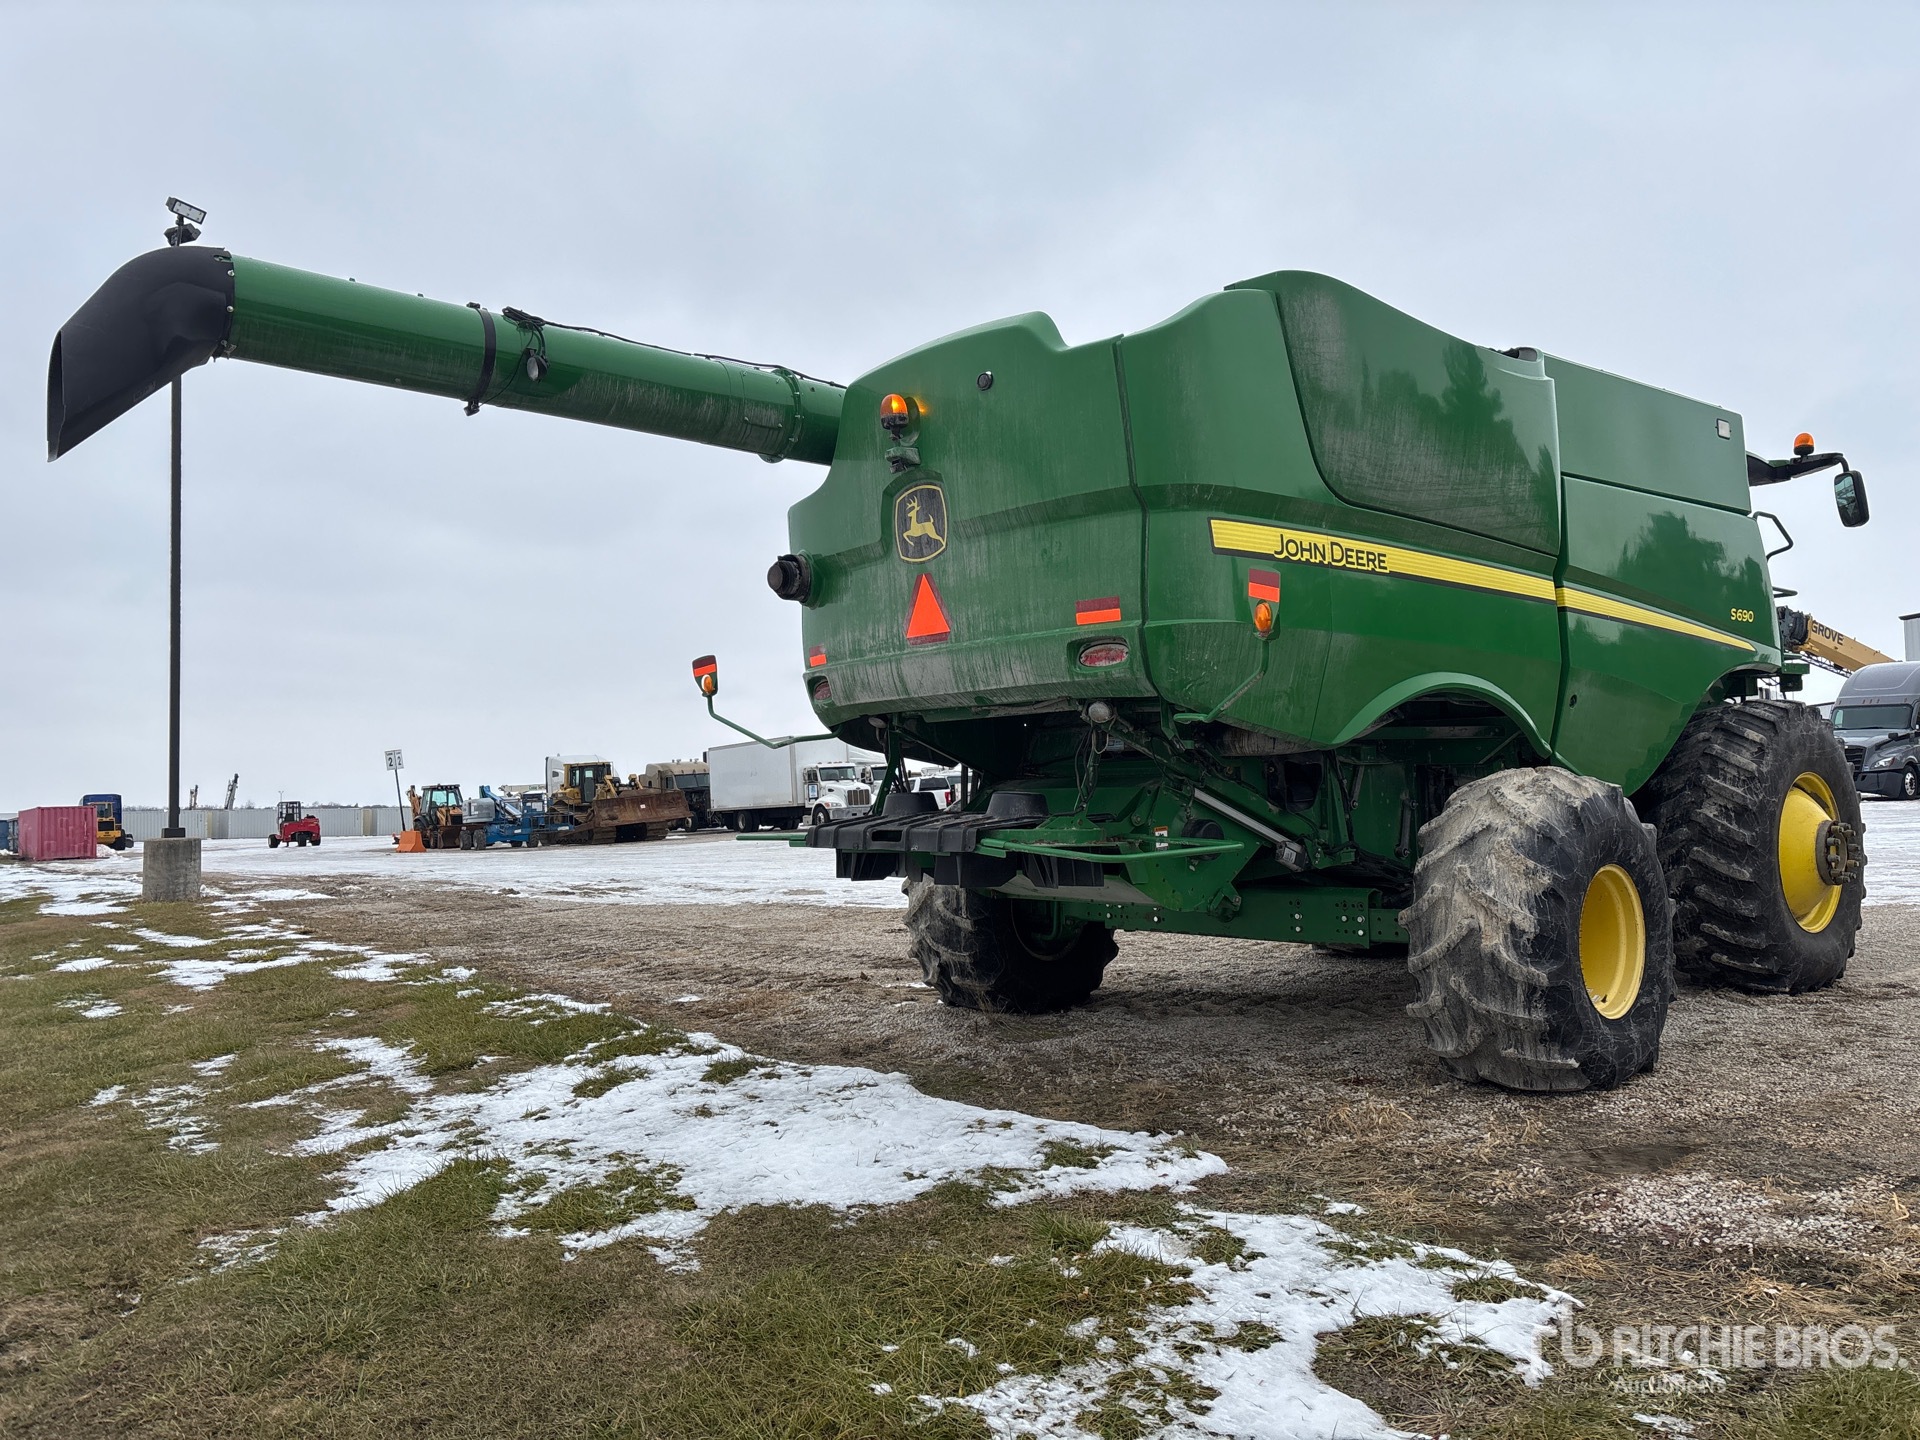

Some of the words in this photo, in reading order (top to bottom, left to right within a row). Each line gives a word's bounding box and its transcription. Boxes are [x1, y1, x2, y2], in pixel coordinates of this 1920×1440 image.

[1274, 534, 1327, 562] JOHN
[1330, 541, 1388, 571] DEERE
[1730, 608, 1754, 623] S690
[1811, 621, 1844, 646] GROVE
[388, 757, 394, 767] 2
